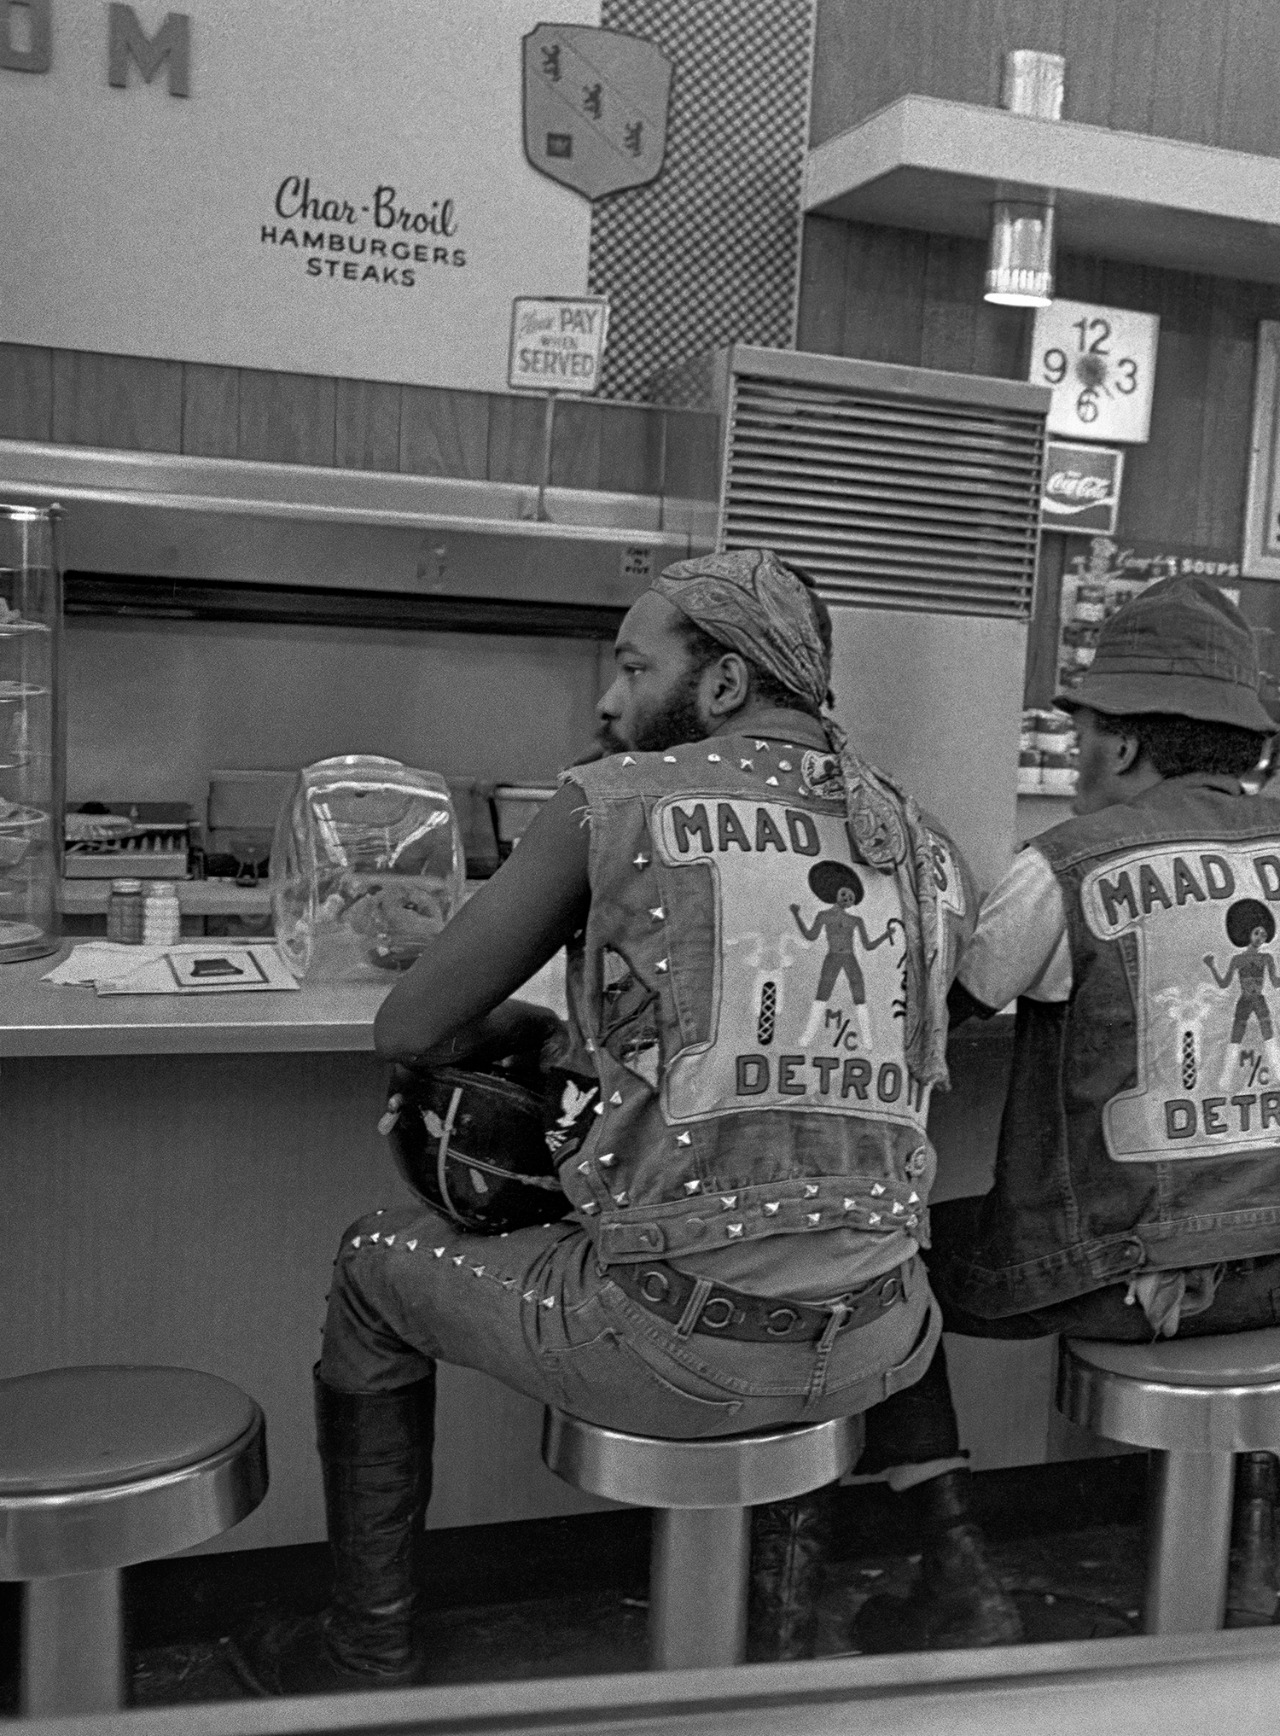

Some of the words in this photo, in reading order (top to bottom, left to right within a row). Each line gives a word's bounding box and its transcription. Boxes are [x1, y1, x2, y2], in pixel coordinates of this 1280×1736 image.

[260, 225, 467, 267] HAMBURGERS
[306, 257, 416, 287] STEAKS
[560, 307, 599, 334] PAY
[1072, 317, 1111, 355] 12
[520, 347, 595, 378] SERVED
[1043, 348, 1068, 384] 9
[1115, 357, 1137, 394] 3
[1077, 386, 1099, 423] 6
[671, 803, 821, 857] MAAD
[1098, 854, 1236, 927] MAAD
[824, 1008, 859, 1051] M/C
